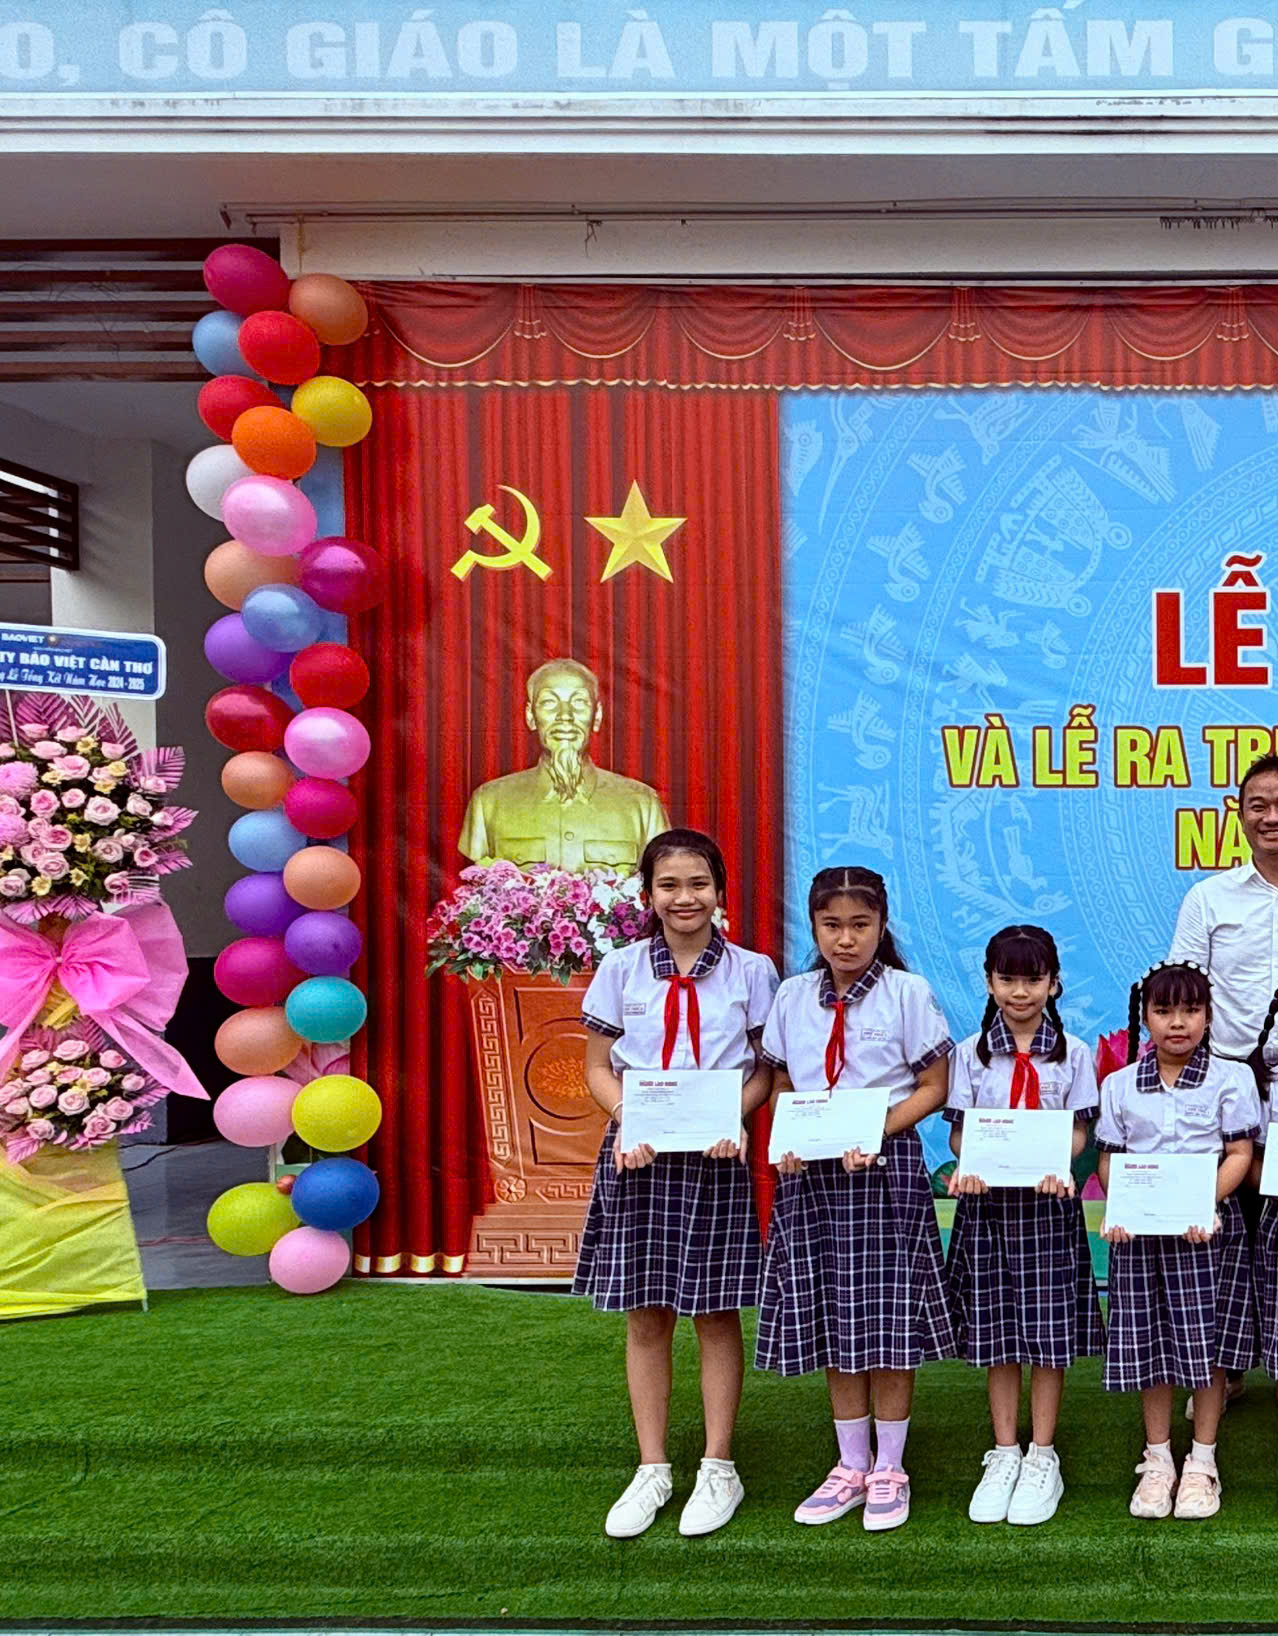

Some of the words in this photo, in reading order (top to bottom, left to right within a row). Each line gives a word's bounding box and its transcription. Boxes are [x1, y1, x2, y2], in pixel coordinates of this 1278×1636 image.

[118, 9, 248, 80] CÔ
[286, 9, 518, 80] GIÁO
[556, 9, 677, 79] LÀ
[711, 8, 927, 90] MỘT
[958, 0, 1174, 77] TẤM
[53, 654, 86, 670] VIỆT
[1153, 552, 1270, 687] LỄ
[942, 714, 1019, 788] VÀ
[1032, 704, 1098, 788] LỄ
[1115, 725, 1191, 788] RA
